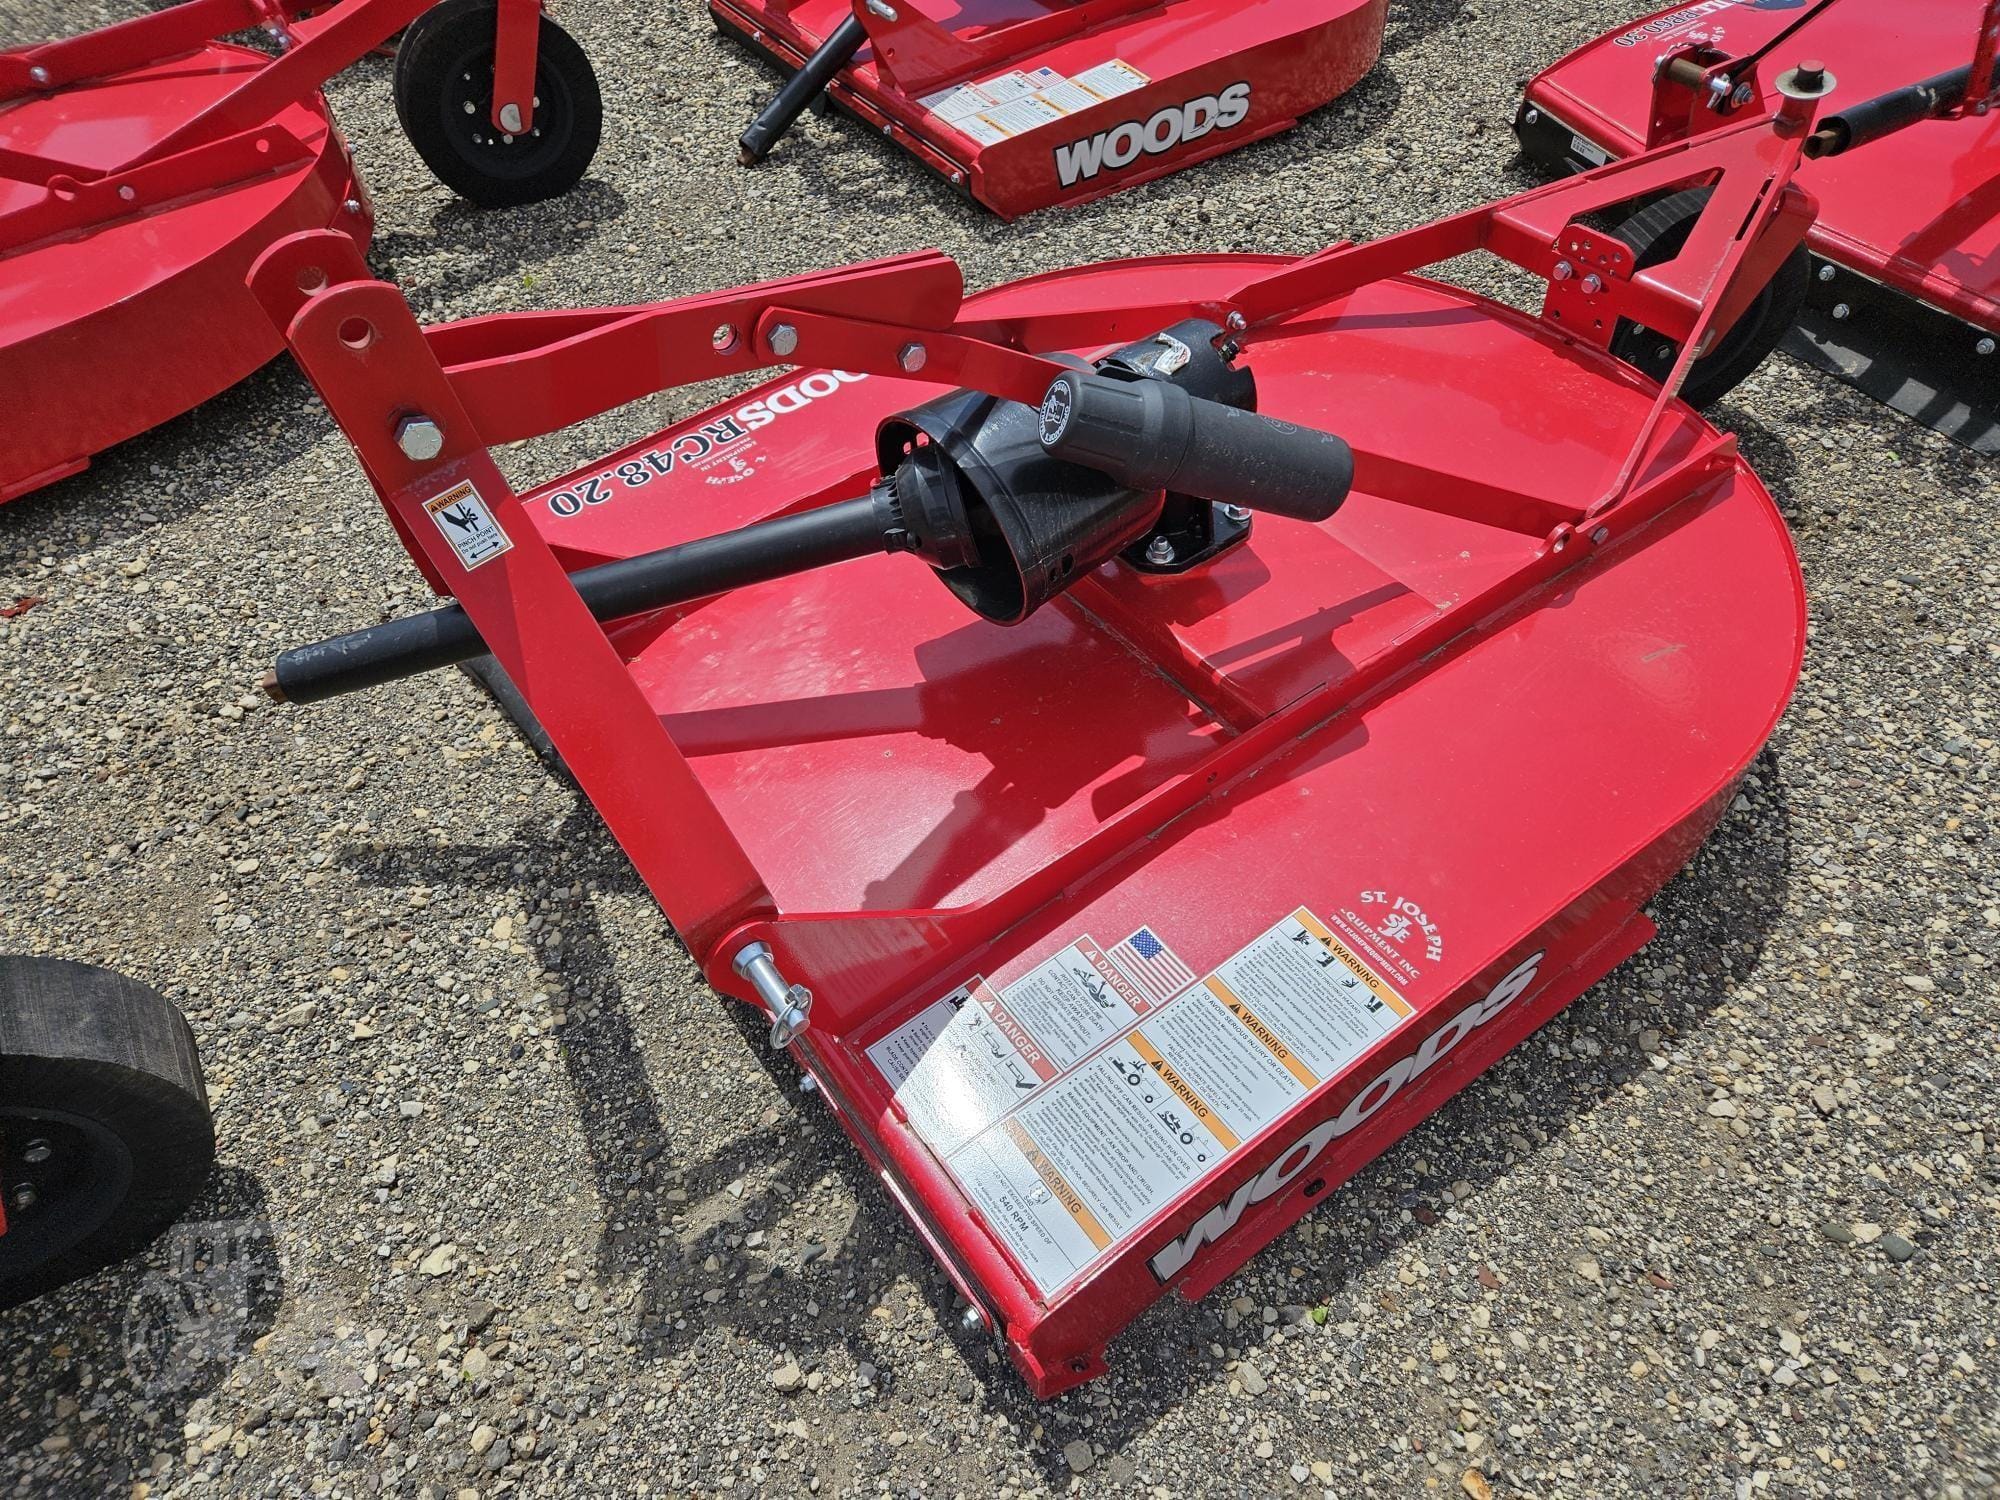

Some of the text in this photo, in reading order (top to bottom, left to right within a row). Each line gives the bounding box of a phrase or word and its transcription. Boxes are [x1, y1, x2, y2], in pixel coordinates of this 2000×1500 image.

[1055, 82, 1251, 187] WOODS
[548, 414, 748, 518] RC48.20
[438, 486, 472, 509] WARNING
[458, 526, 494, 549] PINCH POINT
[1340, 908, 1420, 979] QUIPMENT INC
[1360, 890, 1442, 962] ST. JOSEPH
[1036, 977, 1046, 986] DO
[1042, 984, 1054, 995] NOT
[1094, 959, 1142, 1007] DANGER
[1330, 943, 1381, 989] WARNING
[1046, 969, 1068, 991] CONTACT
[1065, 989, 1077, 1001] CAN
[1074, 999, 1091, 1017] CAUSE
[1055, 987, 1071, 1003] KEEP
[993, 1010, 1042, 1064] DANGER
[1200, 991, 1211, 1001] TO
[1207, 998, 1227, 1017] AVOID
[1223, 1014, 1250, 1040] SERIOUS
[1246, 1037, 1269, 1060] INJURY
[1265, 1057, 1277, 1069] OR
[1239, 1011, 1289, 1059] WARNING
[1094, 1063, 1115, 1085] FALLING
[1112, 1082, 1124, 1095] OFF
[1120, 1092, 1134, 1106] CAN
[1130, 1103, 1150, 1124] RESULT
[1146, 1121, 1155, 1130] IN
[1151, 1127, 1169, 1146] BEING
[1165, 1143, 1179, 1157] RUN
[1147, 951, 1545, 1284] WOODS
[1160, 1068, 1209, 1119] WARNING
[1065, 1090, 1084, 1111] RAISED
[1080, 1108, 1108, 1139] EQUIPMENT
[1103, 1136, 1117, 1150] CAN
[1113, 1147, 1129, 1164] DROP
[1125, 1162, 1139, 1176] AND
[1022, 1193, 1035, 1207] 540
[1035, 1159, 1083, 1215] WARNING
[997, 1194, 1030, 1233] 540 RPM
